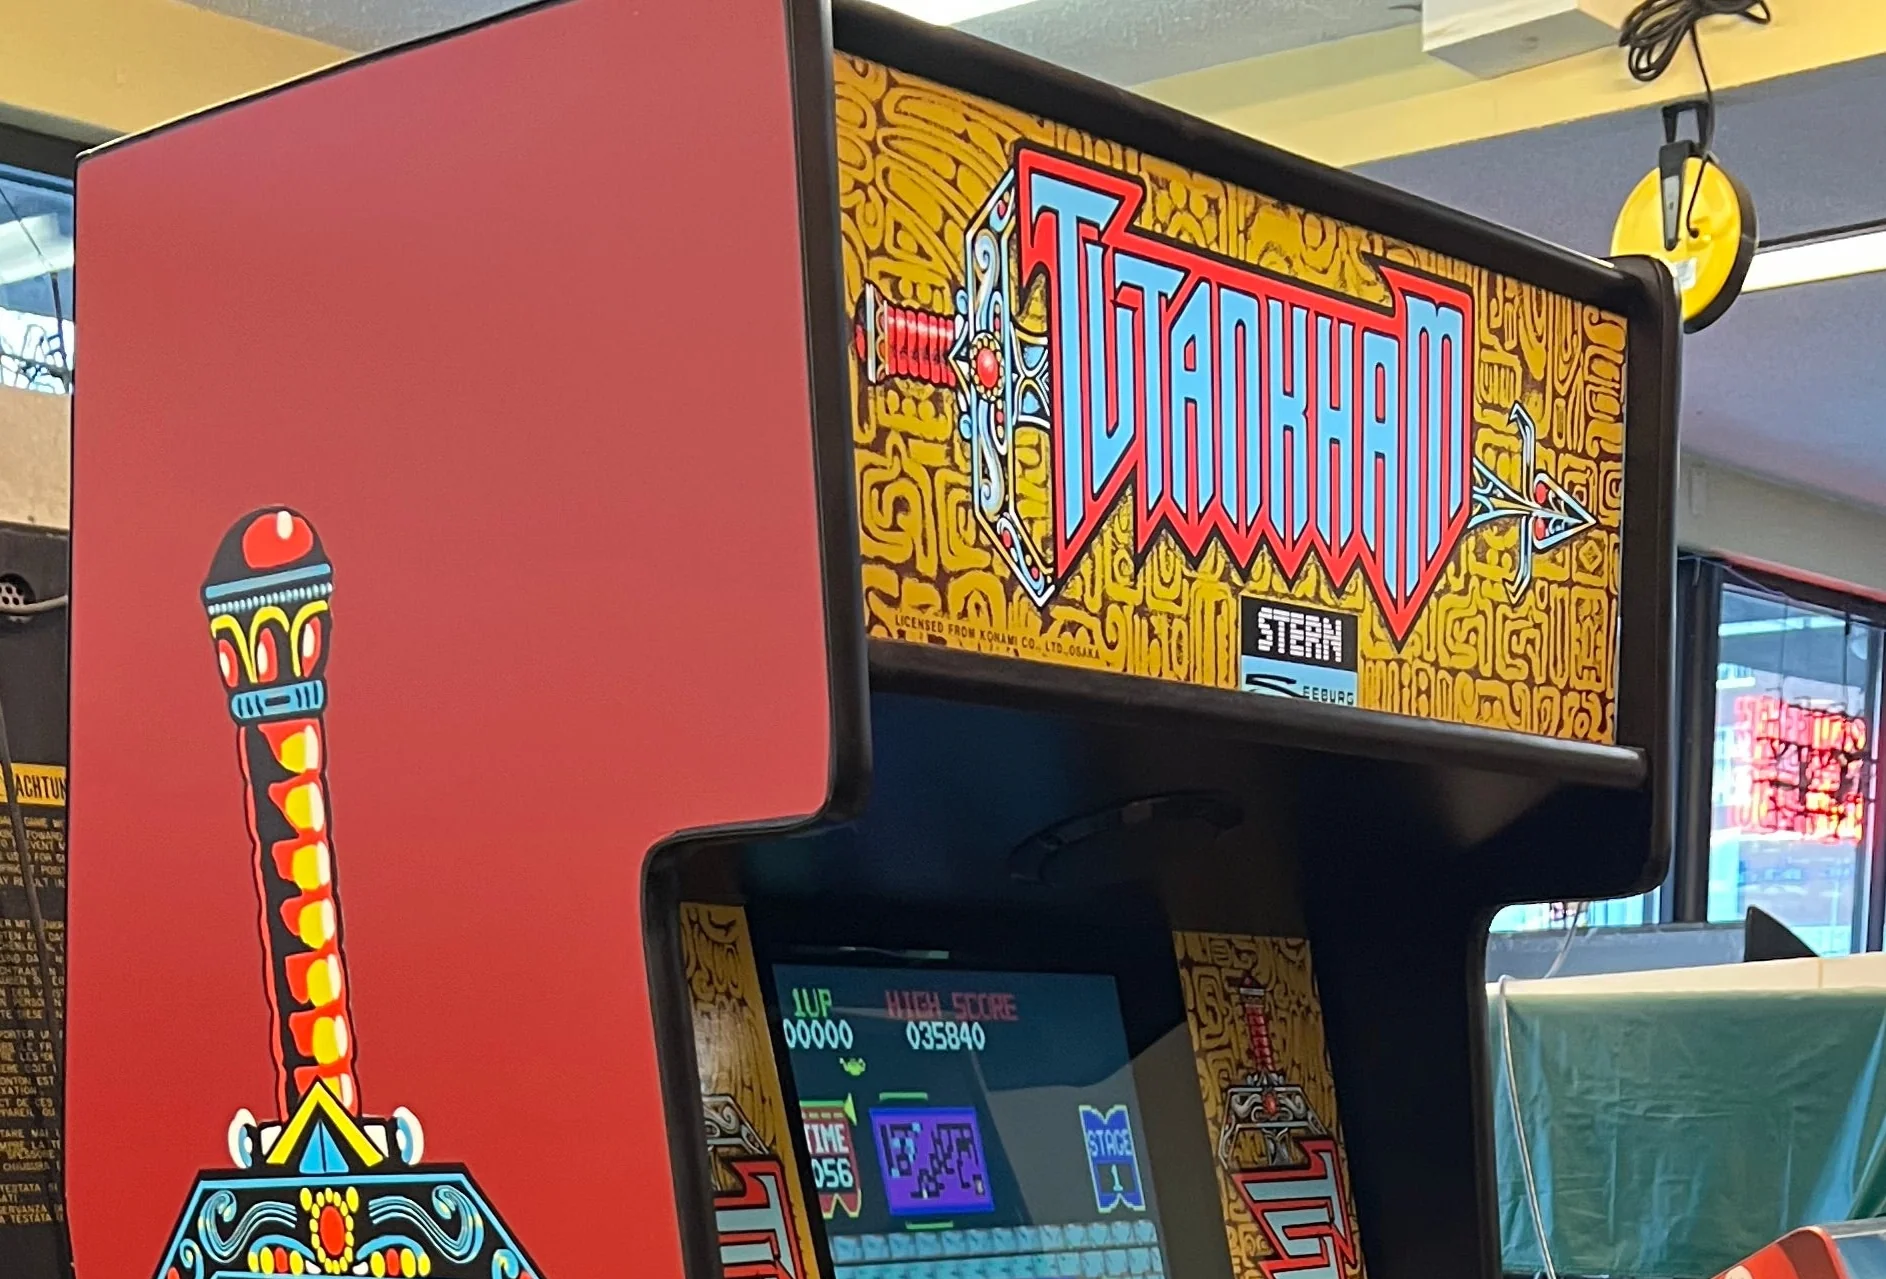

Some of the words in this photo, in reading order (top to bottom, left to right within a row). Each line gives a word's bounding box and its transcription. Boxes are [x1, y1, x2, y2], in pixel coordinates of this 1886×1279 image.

[1029, 170, 1469, 602] TUTANKHAM
[895, 614, 945, 634] LICENSED
[948, 624, 976, 639] FROM
[980, 630, 1018, 647] KONAMI
[1258, 606, 1342, 663] STERN
[792, 988, 832, 1018] 1UP
[885, 990, 943, 1020] HIGH
[952, 992, 1019, 1022] SCORE
[906, 1021, 985, 1050] 035840
[803, 1123, 850, 1155] TIME
[1087, 1129, 1133, 1157] STAGE
[811, 1157, 854, 1190] 056
[1111, 1163, 1124, 1192] 1
